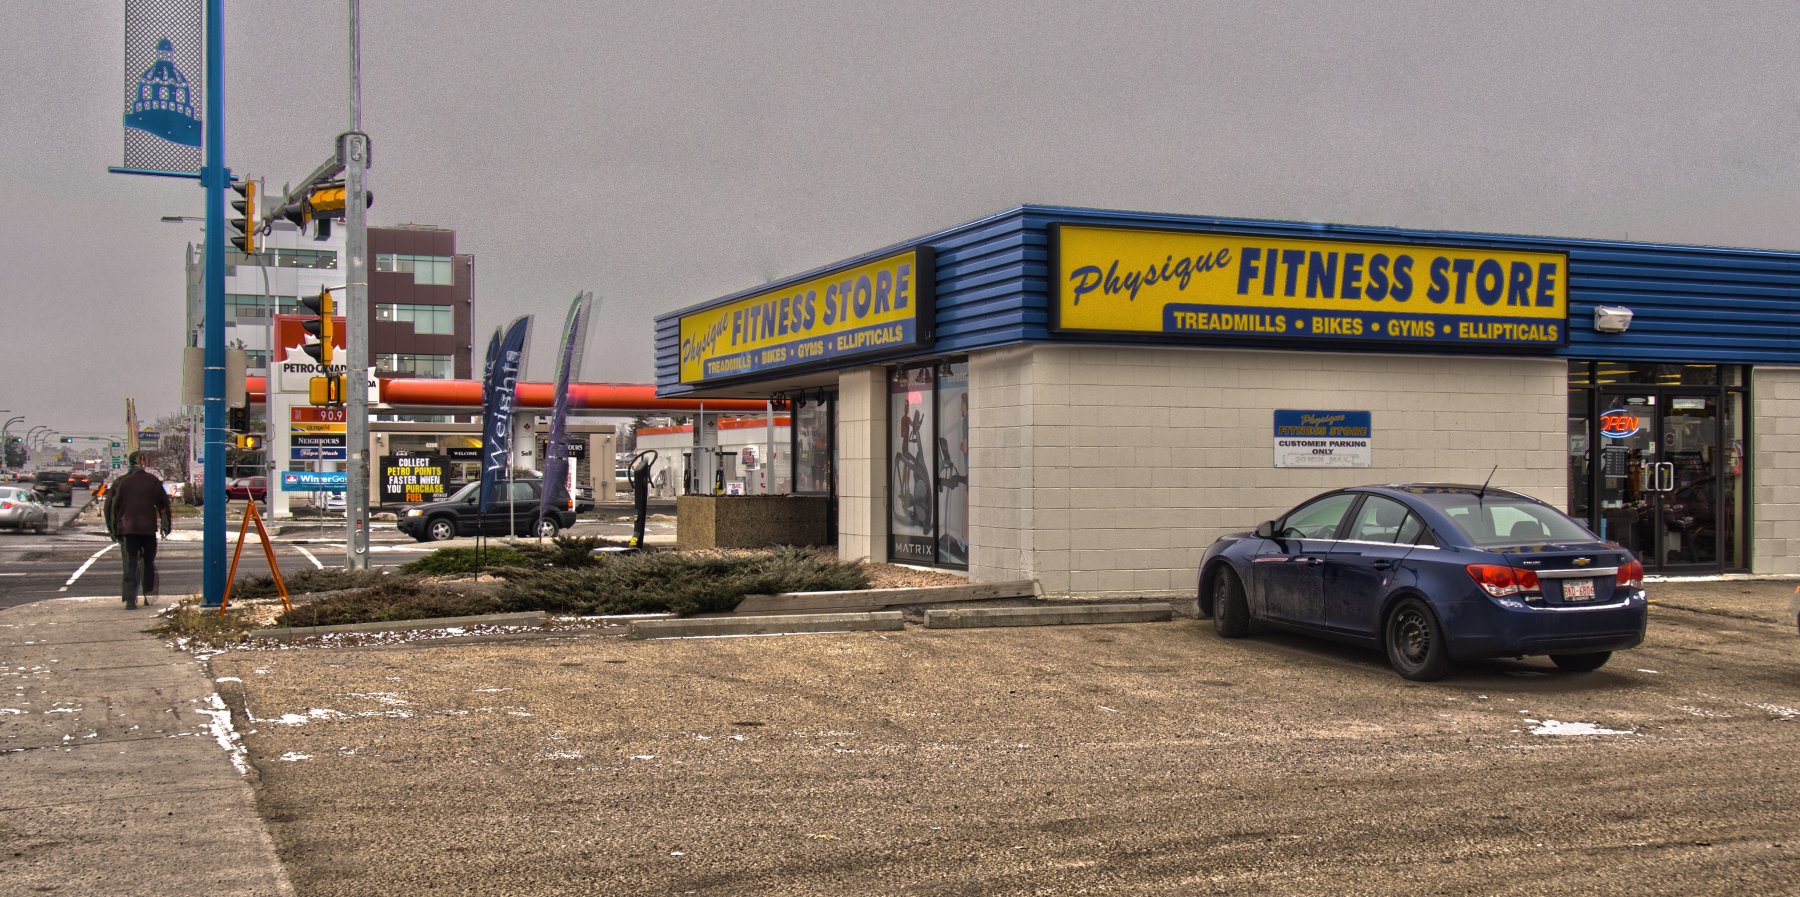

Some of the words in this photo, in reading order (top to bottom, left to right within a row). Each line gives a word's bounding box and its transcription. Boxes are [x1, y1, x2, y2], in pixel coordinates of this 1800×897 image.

[1069, 247, 1233, 306] Physique
[1237, 246, 1415, 302] FITNESS
[1426, 256, 1557, 307] STORE
[682, 312, 729, 371] Physique
[731, 289, 817, 346] FITNESS
[823, 263, 911, 326] STORE
[1173, 311, 1287, 333] TREADMILLS
[1312, 316, 1364, 335] BIKES
[1388, 319, 1435, 337] GYMS
[1459, 322, 1559, 341] ELLIPTICALS
[707, 354, 752, 375] TREADMILLS
[761, 347, 787, 365] BIKES
[797, 341, 824, 358] GYMS
[837, 325, 904, 351] ELLIPTICALS
[320, 410, 343, 421] 90.9
[1600, 415, 1640, 431] OPEN
[1278, 426, 1327, 436] FITNESS
[1329, 426, 1368, 436] STORE
[398, 458, 430, 467] COLLECT
[387, 467, 411, 476] PETRO
[414, 467, 442, 476] POINTS
[388, 475, 417, 485] FASTER
[419, 475, 441, 484] WHEN
[387, 484, 402, 494] YOU
[405, 484, 444, 493] PURCHASE
[405, 493, 424, 503] FUEL
[895, 542, 932, 555] MATRIX
